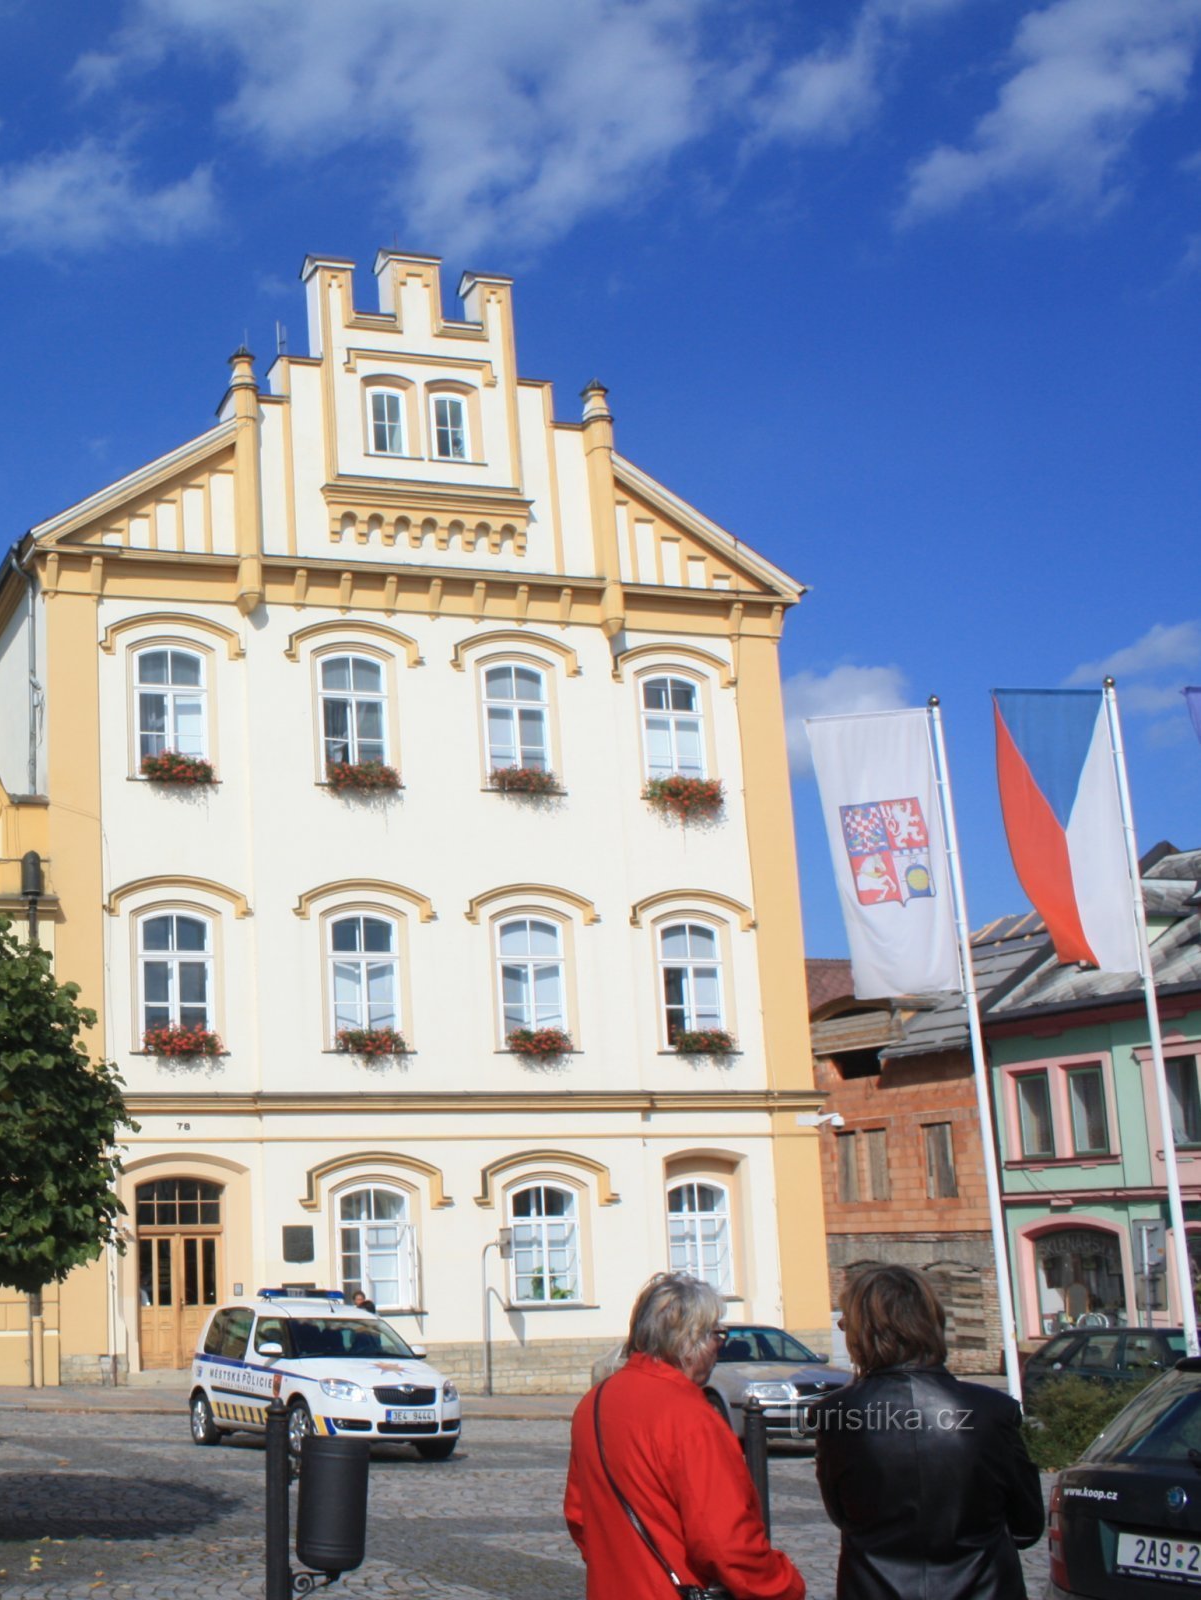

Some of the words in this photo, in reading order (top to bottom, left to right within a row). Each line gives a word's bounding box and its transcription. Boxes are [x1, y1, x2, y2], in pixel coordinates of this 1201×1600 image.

[176, 1122, 191, 1131] 78
[242, 1371, 273, 1389] POLICIE
[1063, 1486, 1118, 1501] www.koop.cz
[1133, 1537, 1171, 1568] 2A9
